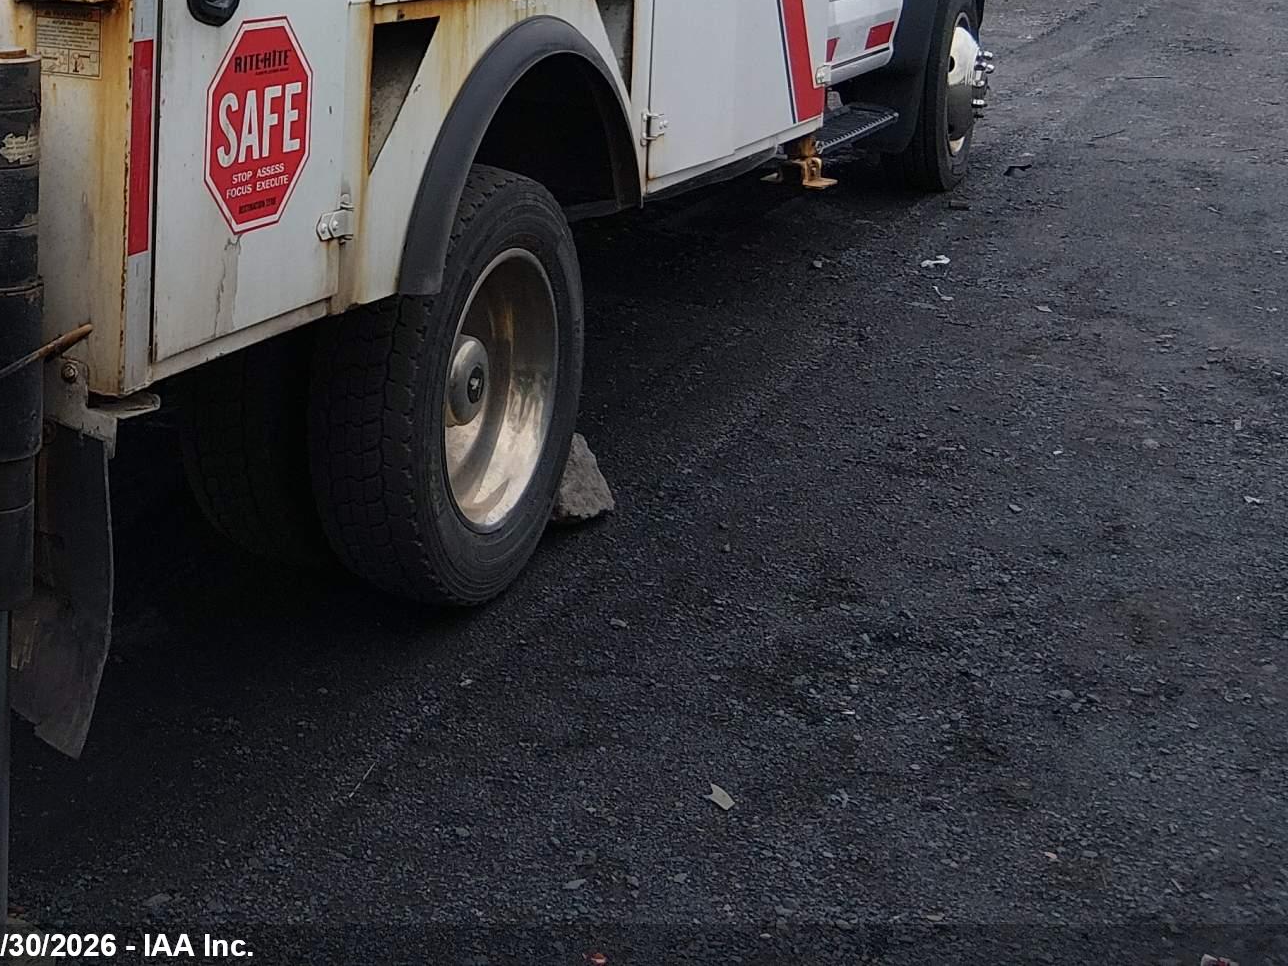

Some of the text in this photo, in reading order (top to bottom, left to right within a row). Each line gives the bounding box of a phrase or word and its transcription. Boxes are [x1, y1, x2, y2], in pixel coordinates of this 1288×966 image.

[234, 49, 289, 74] RITE-HITE
[216, 81, 302, 168] SAFE
[232, 163, 285, 184] STOP ASSESS
[226, 175, 289, 199] FOCUS EXECUTE
